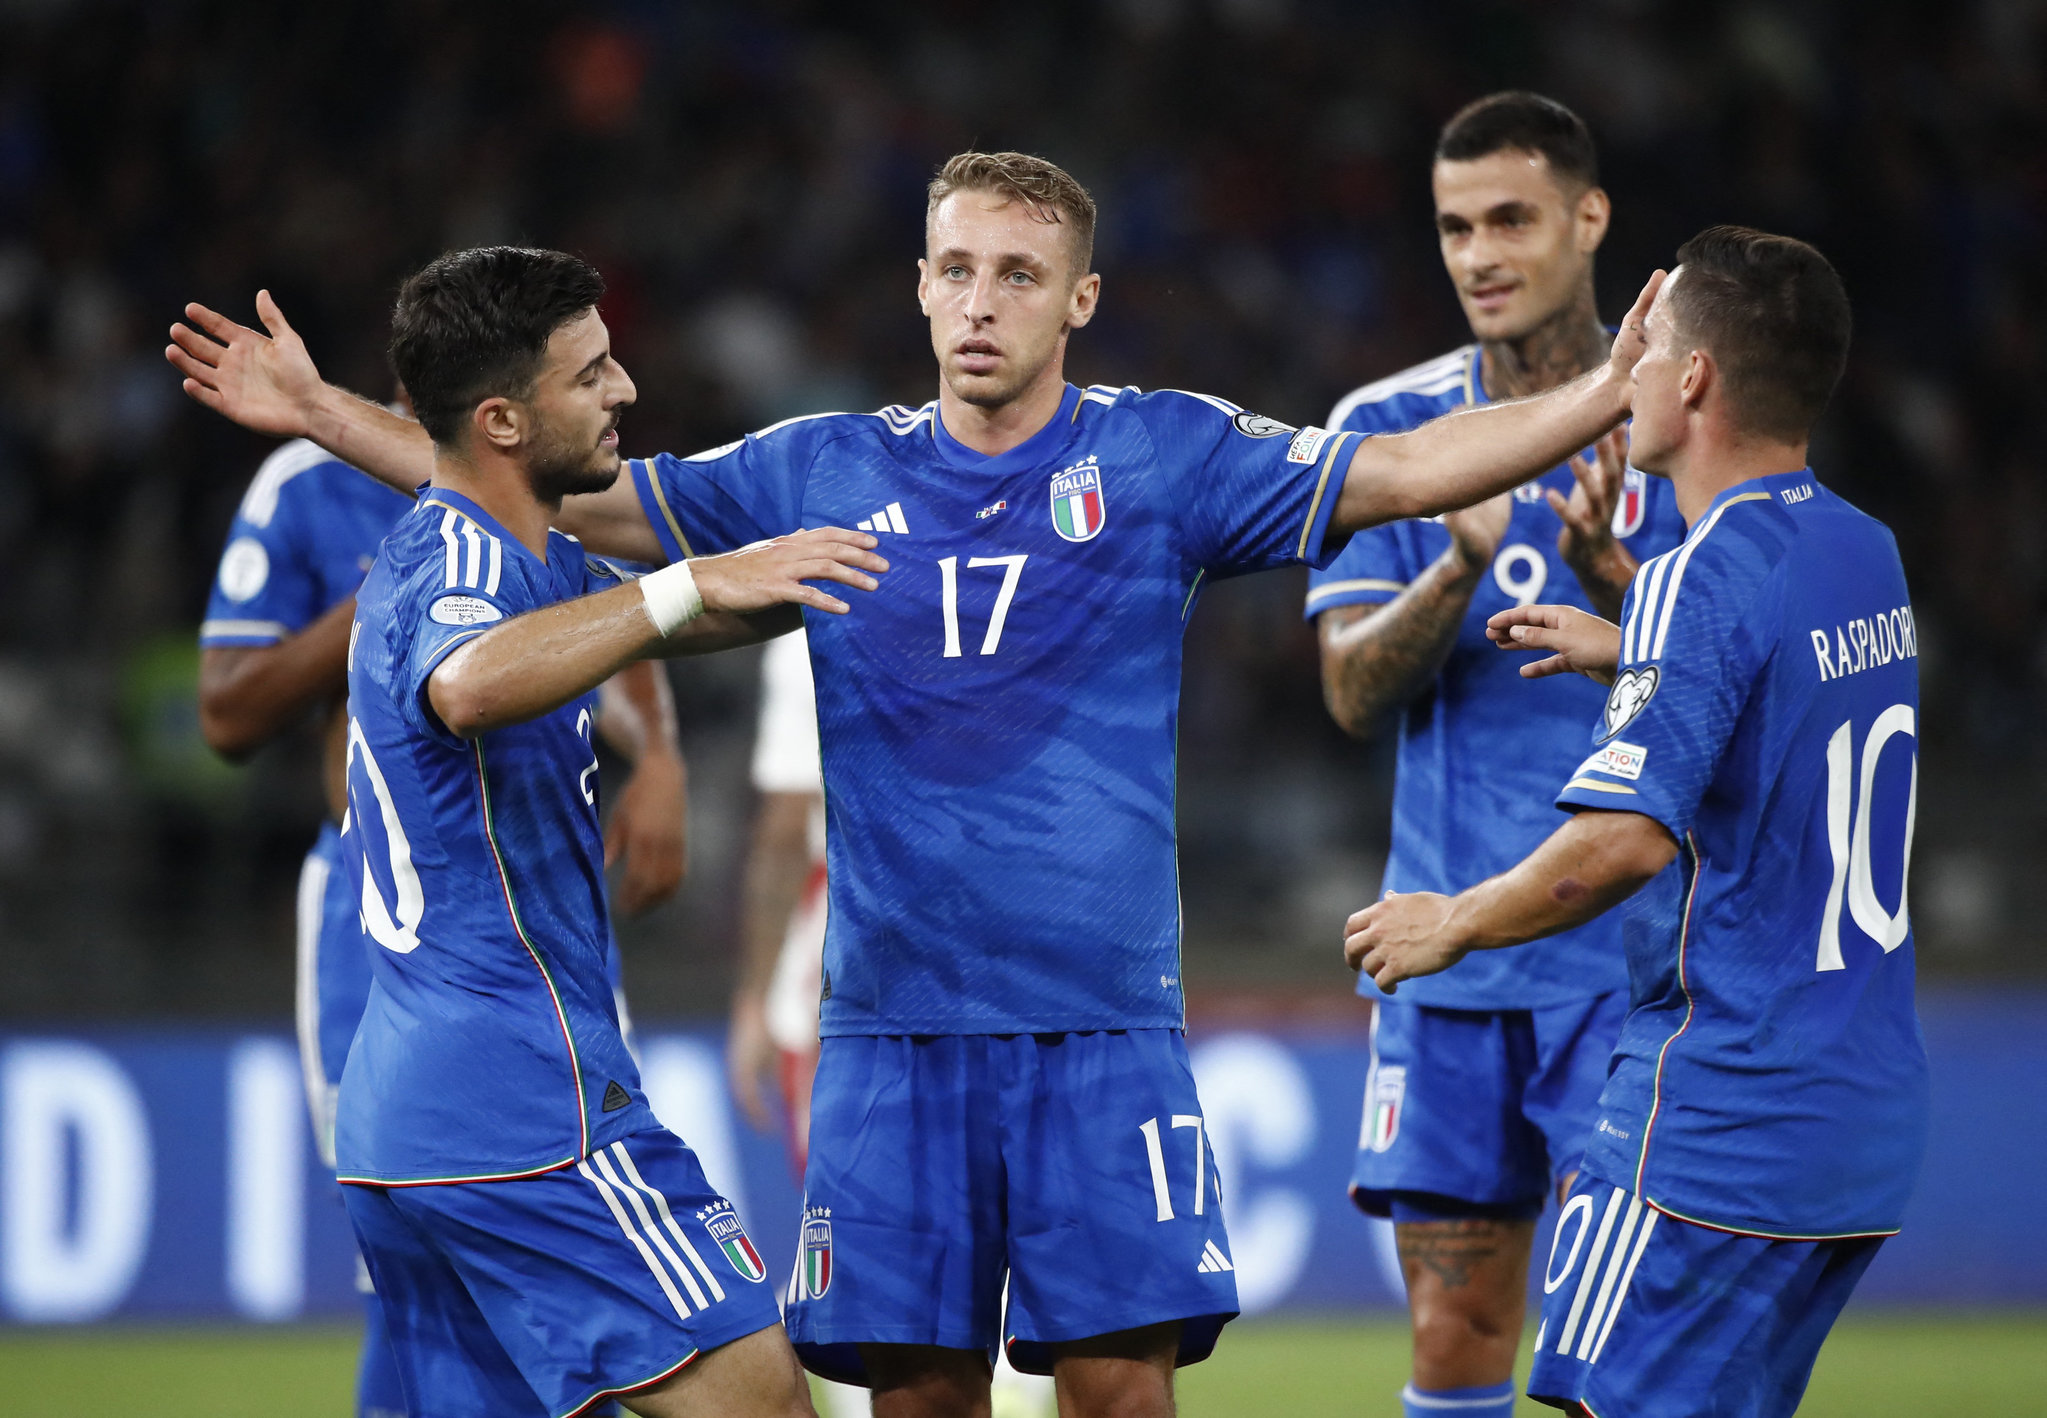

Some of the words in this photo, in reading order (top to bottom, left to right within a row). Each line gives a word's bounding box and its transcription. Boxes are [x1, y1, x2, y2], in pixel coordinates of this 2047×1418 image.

[1290, 441, 1301, 460] UEFA
[1053, 471, 1096, 496] ITALIA
[1780, 483, 1815, 505] ITALIA
[1493, 543, 1548, 609] 9
[937, 554, 1030, 658] 17
[576, 703, 599, 807] 2
[1815, 703, 1918, 972] 10
[1138, 1114, 1205, 1223] 17
[710, 1218, 739, 1238] ITALIA
[807, 1227, 829, 1243] ITALIA
